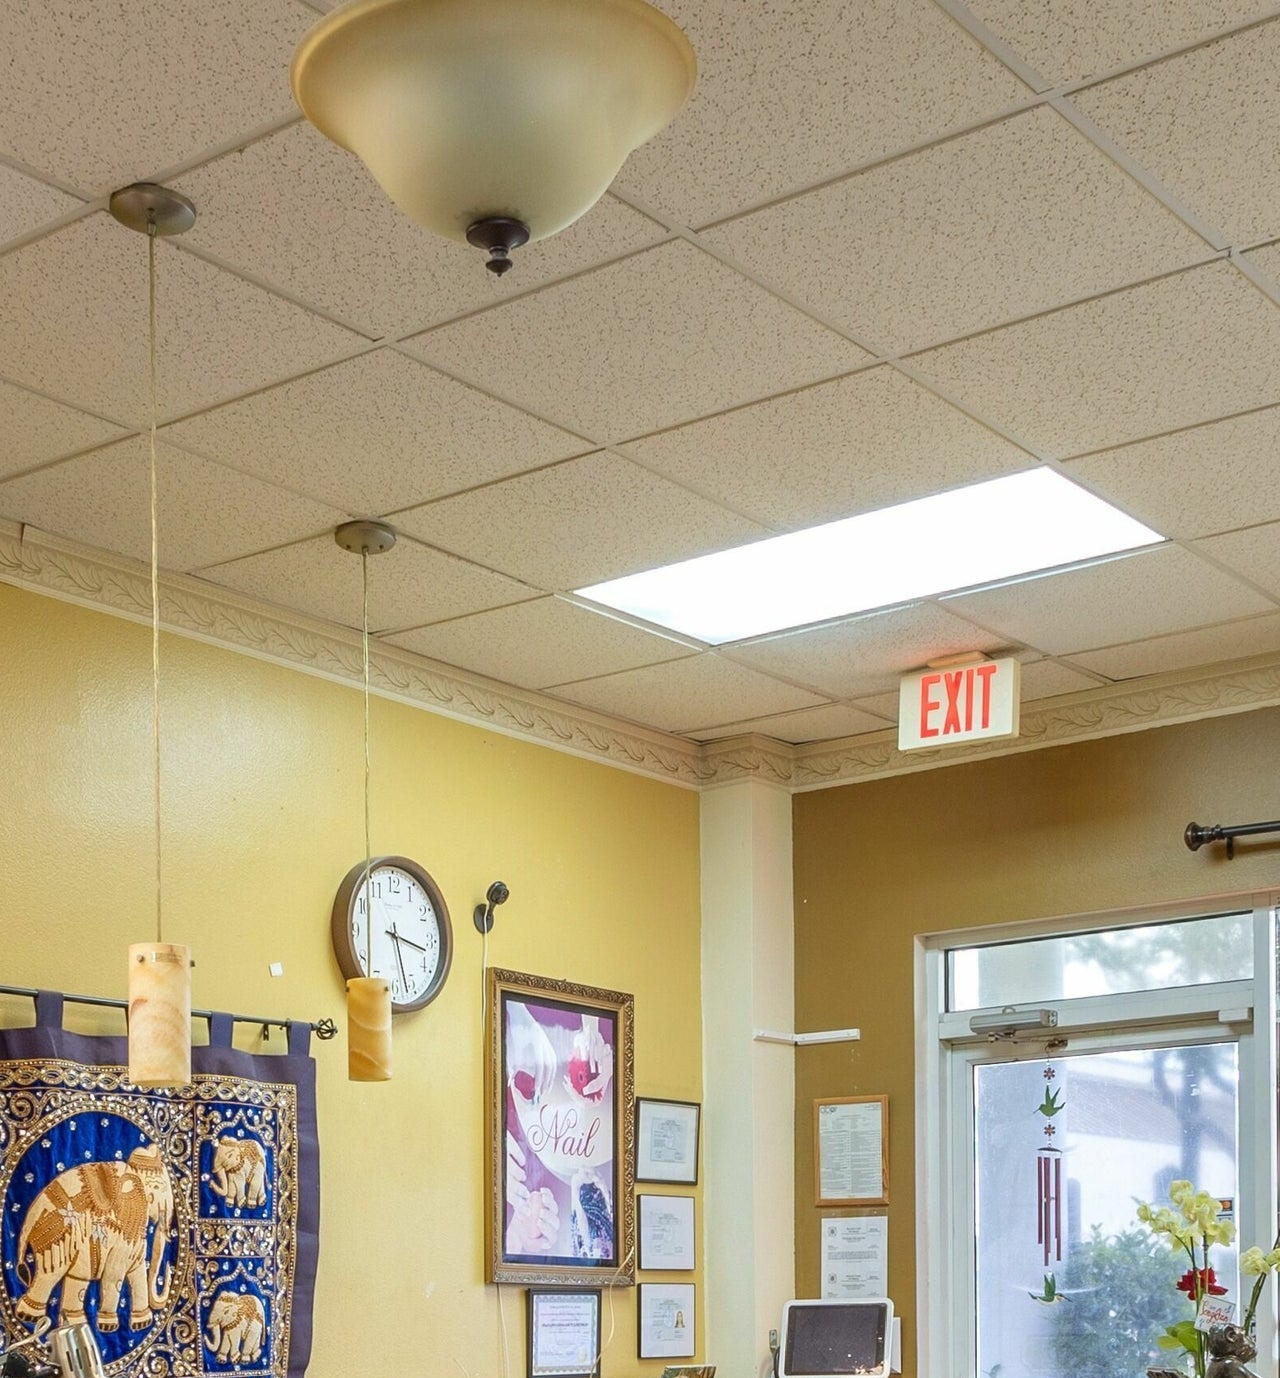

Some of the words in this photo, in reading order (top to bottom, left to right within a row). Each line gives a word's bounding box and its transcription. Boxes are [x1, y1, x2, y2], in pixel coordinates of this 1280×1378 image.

[920, 665, 996, 739] EXIT
[371, 881, 382, 899] 11
[388, 876, 400, 893] 12
[419, 905, 427, 922] 2
[426, 932, 434, 949] 3
[420, 956, 427, 973] 4
[392, 979, 398, 995] 6
[527, 1104, 600, 1158] Nail
